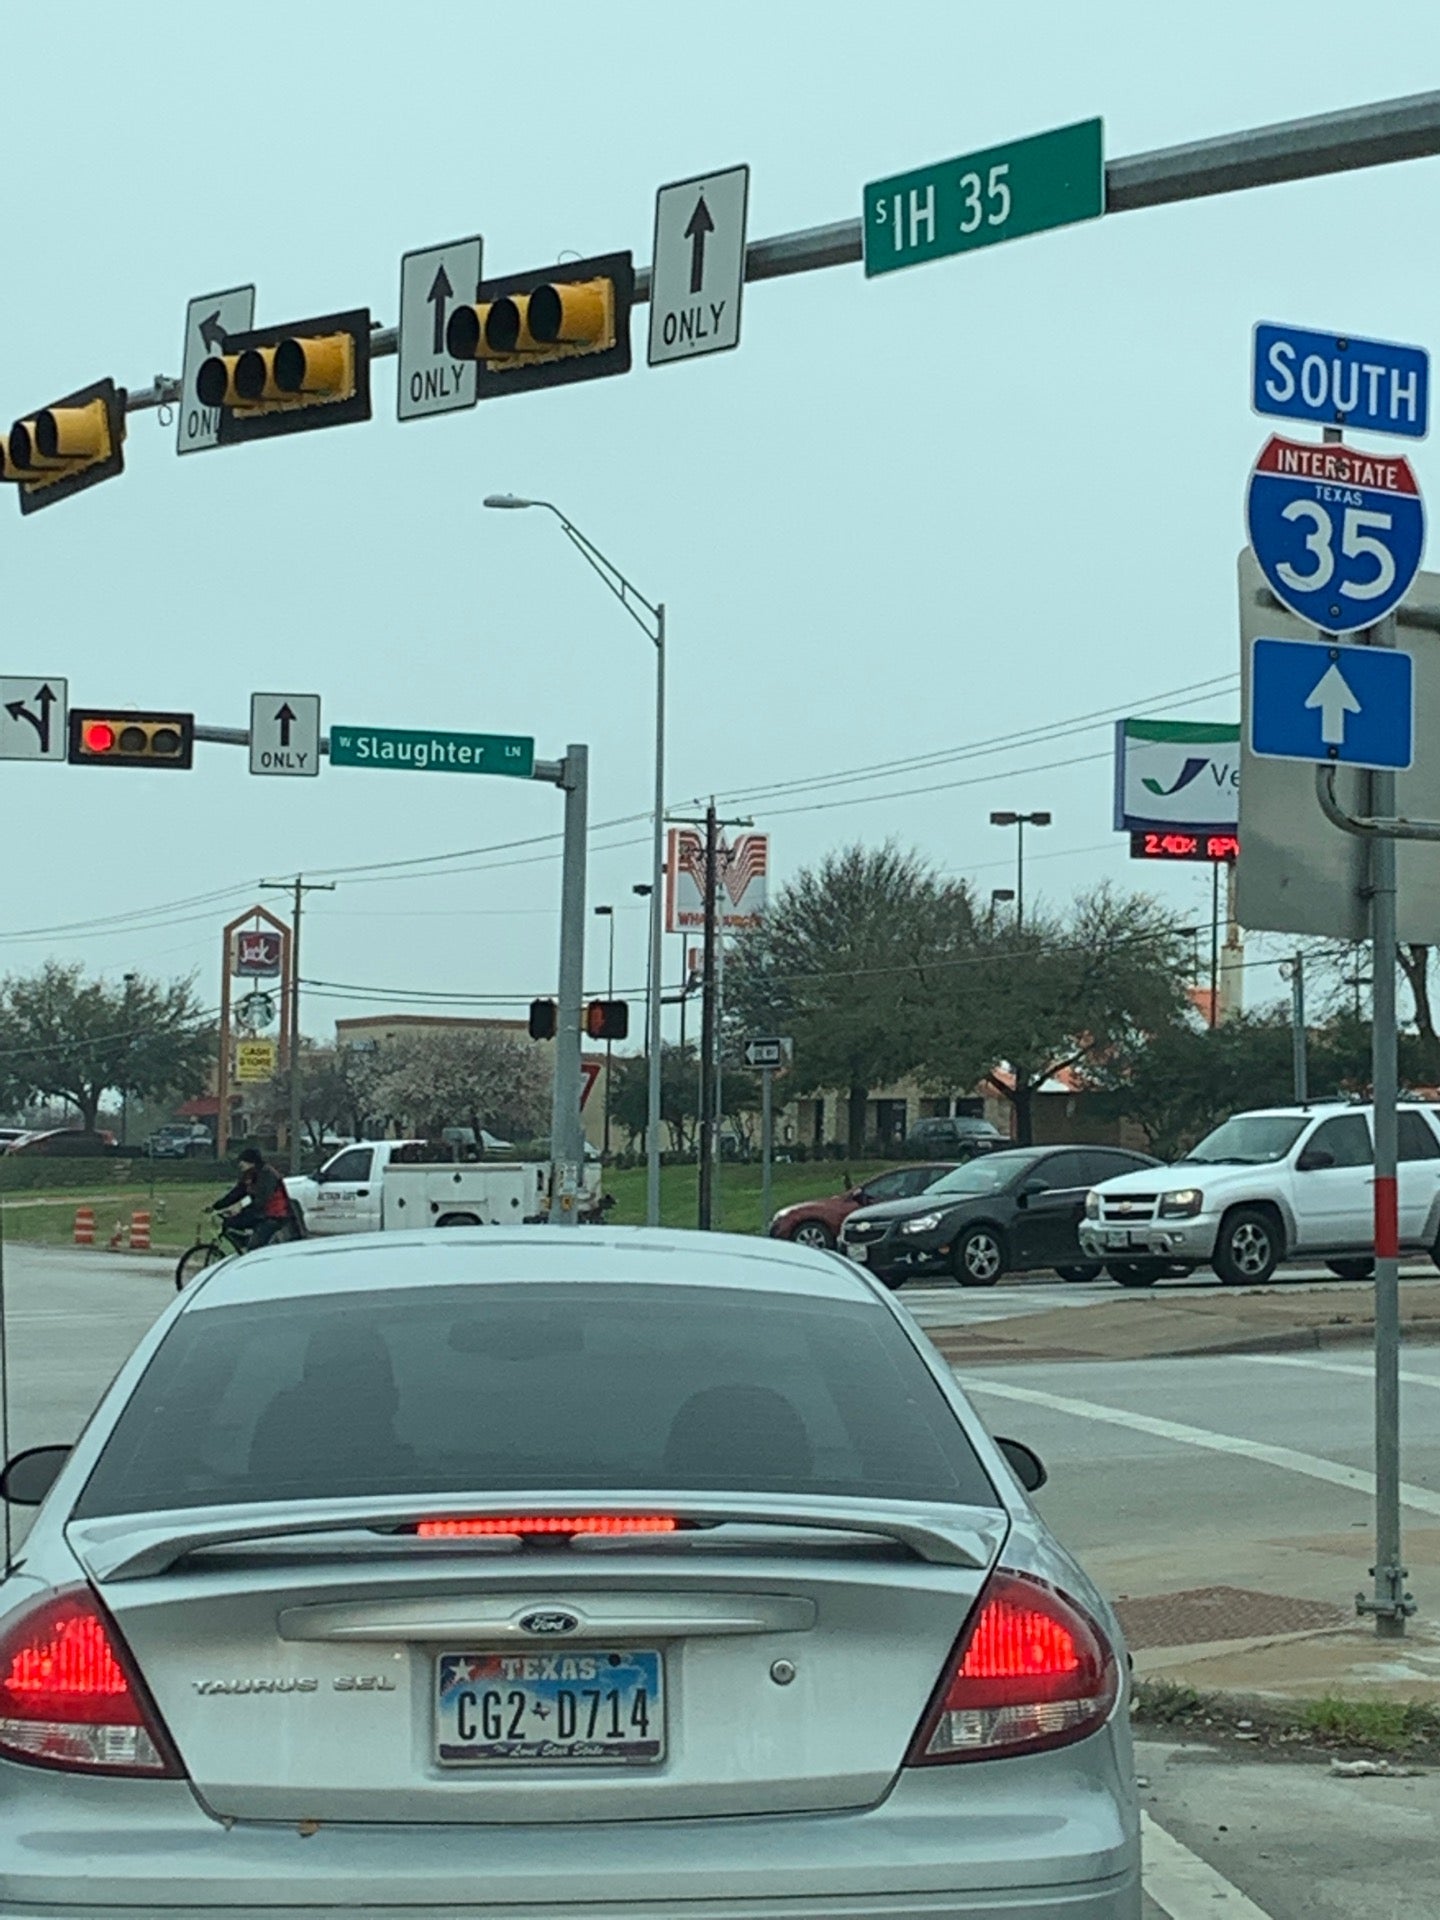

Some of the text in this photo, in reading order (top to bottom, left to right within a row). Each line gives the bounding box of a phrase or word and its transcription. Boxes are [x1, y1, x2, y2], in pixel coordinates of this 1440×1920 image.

[875, 163, 1011, 252] S IH 35
[663, 299, 727, 346] ONLY
[410, 366, 464, 402] ONLY
[1264, 341, 1418, 423] SOUTH
[1277, 448, 1399, 490] INTERSTATE
[1315, 484, 1363, 507] TEXAS
[1275, 498, 1397, 601] 35
[260, 751, 308, 769] ONLY
[339, 736, 522, 768] W Slaughter LN
[530, 1613, 566, 1632] Ford
[191, 1674, 397, 1695] TAURUS SEL
[500, 1657, 597, 1682] TEXAS
[457, 1688, 650, 1741] CG2 D714
